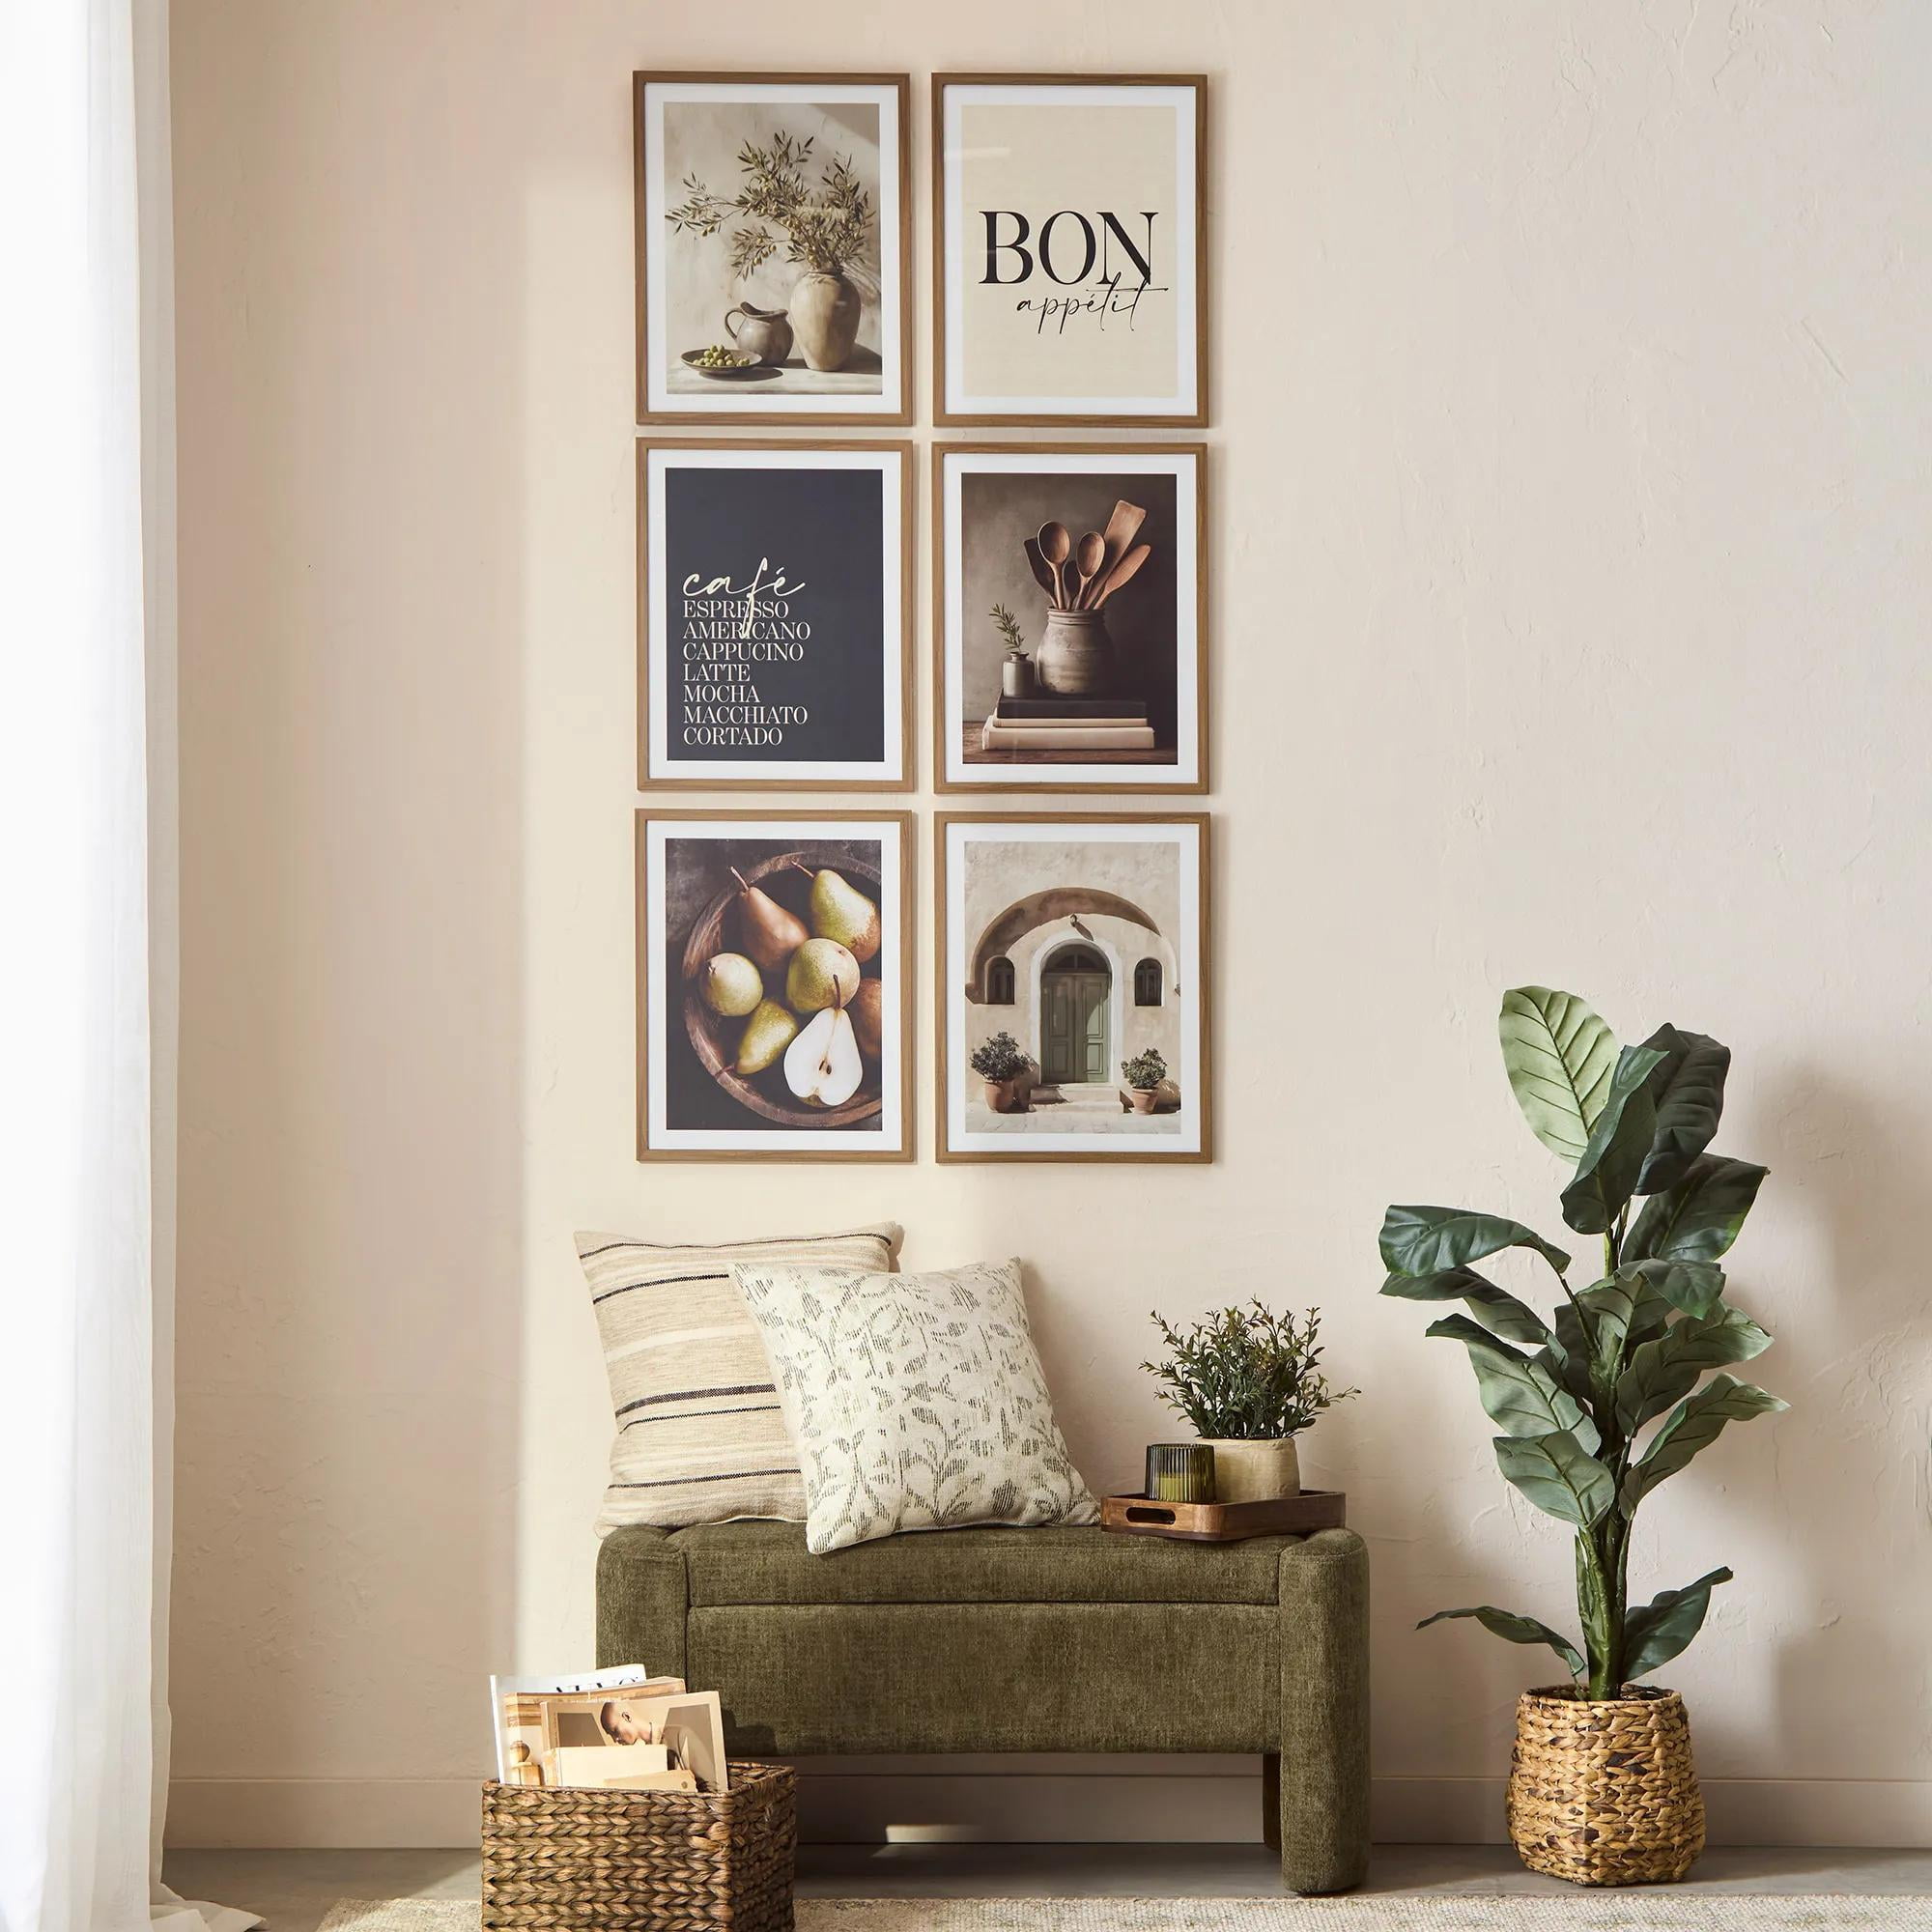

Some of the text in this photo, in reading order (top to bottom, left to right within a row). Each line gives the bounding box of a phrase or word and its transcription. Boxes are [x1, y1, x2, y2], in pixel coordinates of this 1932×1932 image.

[978, 211, 1159, 285] BON
[1016, 271, 1169, 334] appétit
[682, 556, 806, 639] café
[683, 600, 789, 618] ESPRESSO
[682, 621, 810, 640] AMERICANO
[683, 642, 804, 661] CAPPUCINO
[683, 664, 751, 682] LATTE
[683, 684, 760, 703] MOCHA
[683, 706, 808, 724] MACCHIATO
[683, 726, 782, 746] CORTADO
